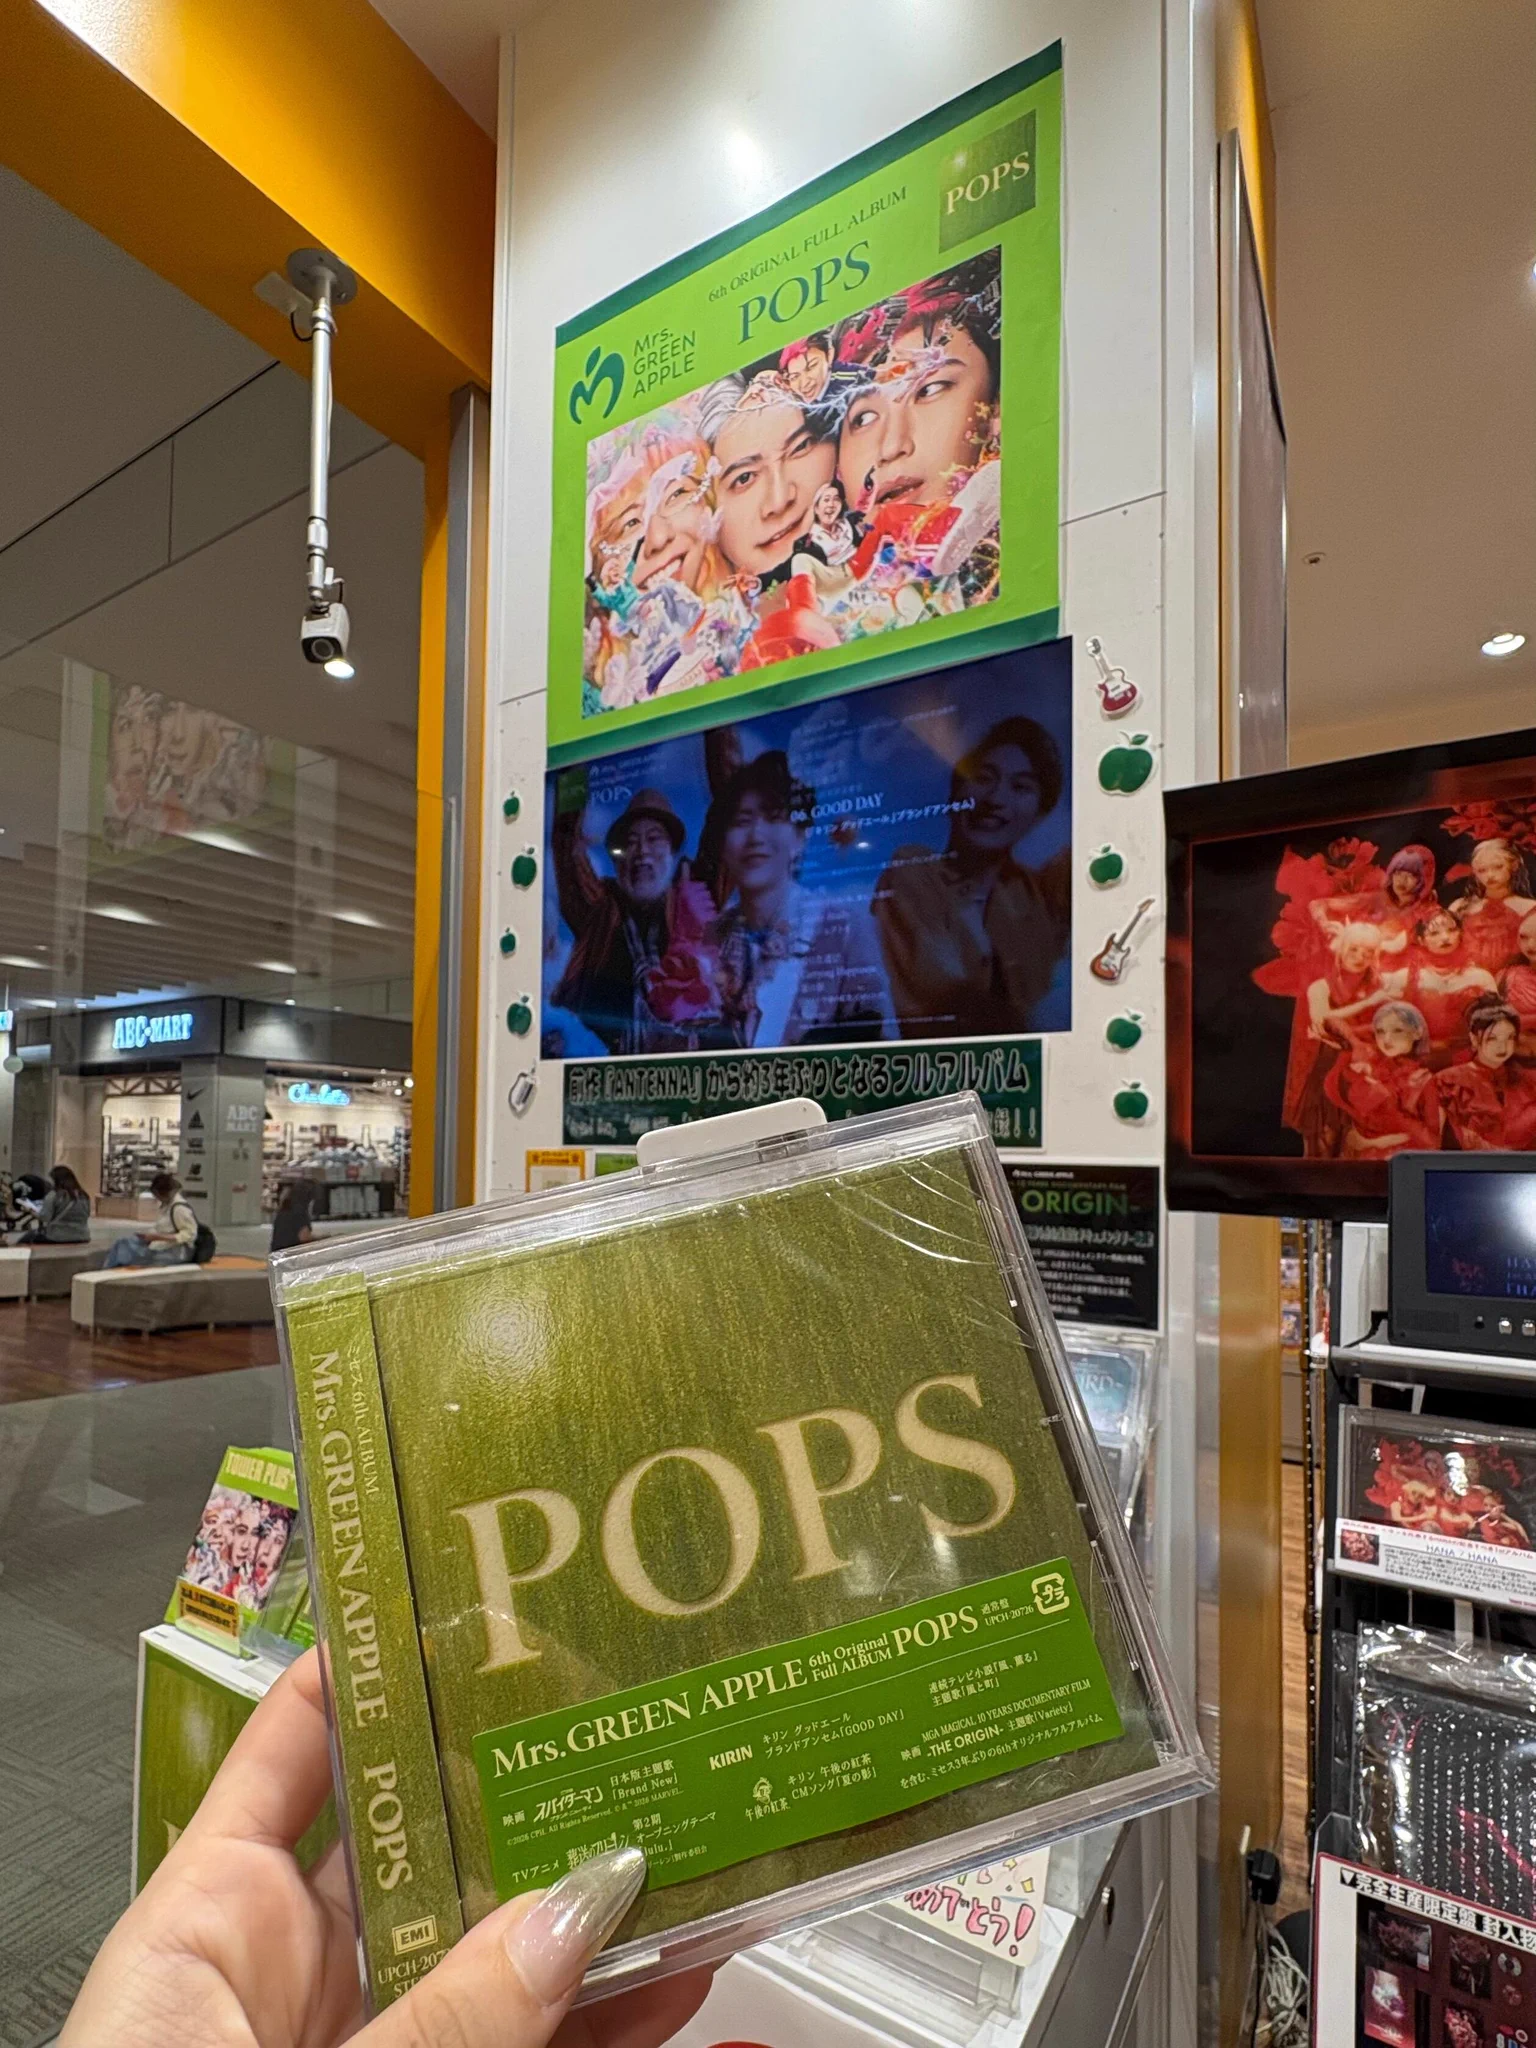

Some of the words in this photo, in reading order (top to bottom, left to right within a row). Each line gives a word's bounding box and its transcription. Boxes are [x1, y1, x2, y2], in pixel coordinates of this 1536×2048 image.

[944, 151, 1031, 215] POPS
[708, 287, 729, 302] 6th
[729, 246, 799, 291] ORIGINAL
[803, 222, 844, 254] FULL
[847, 186, 907, 231] ALBUM
[736, 241, 871, 345] POPS
[633, 329, 674, 357] Mrs.
[633, 331, 697, 377] GREEN
[632, 352, 696, 399] APPLE
[811, 799, 852, 819] GOOD
[856, 793, 884, 810] DAY
[356, 1425, 380, 1496] ALBUM
[450, 1373, 1017, 1675] POPS
[1425, 1544, 1456, 1558] HANA
[1467, 1553, 1499, 1565] HANA
[891, 1604, 979, 1658] POPS
[808, 1652, 832, 1669] 6th
[833, 1635, 889, 1662] Original
[812, 1665, 839, 1683] Full
[840, 1648, 893, 1673] ALBUM
[699, 1659, 808, 1716] APPLE
[762, 1730, 788, 1746] キリン
[793, 1711, 852, 1738] グッドエール
[921, 1729, 941, 1745] MGA
[941, 1715, 977, 1736] MAGICAL
[985, 1704, 1014, 1722] YEARS
[1013, 1684, 1072, 1714] DOCUMENTARY
[1071, 1678, 1092, 1694] FILM
[337, 1582, 389, 1729] APPLE
[363, 1758, 413, 1891] POPS
[900, 1744, 922, 1762] 映画
[609, 1759, 676, 1789] 日本版主題歌
[709, 1744, 754, 1771] KIRIN
[787, 1771, 816, 1787] キリン
[819, 1752, 873, 1779] 午後の紅茶
[502, 1809, 526, 1828] 映画
[632, 1812, 662, 1832] 第2期
[636, 1811, 718, 1843] オープニングテーマ
[512, 1858, 560, 1884] TVアニメ
[400, 1925, 430, 1945] EMI
[377, 1948, 451, 1985] UPCH-207
